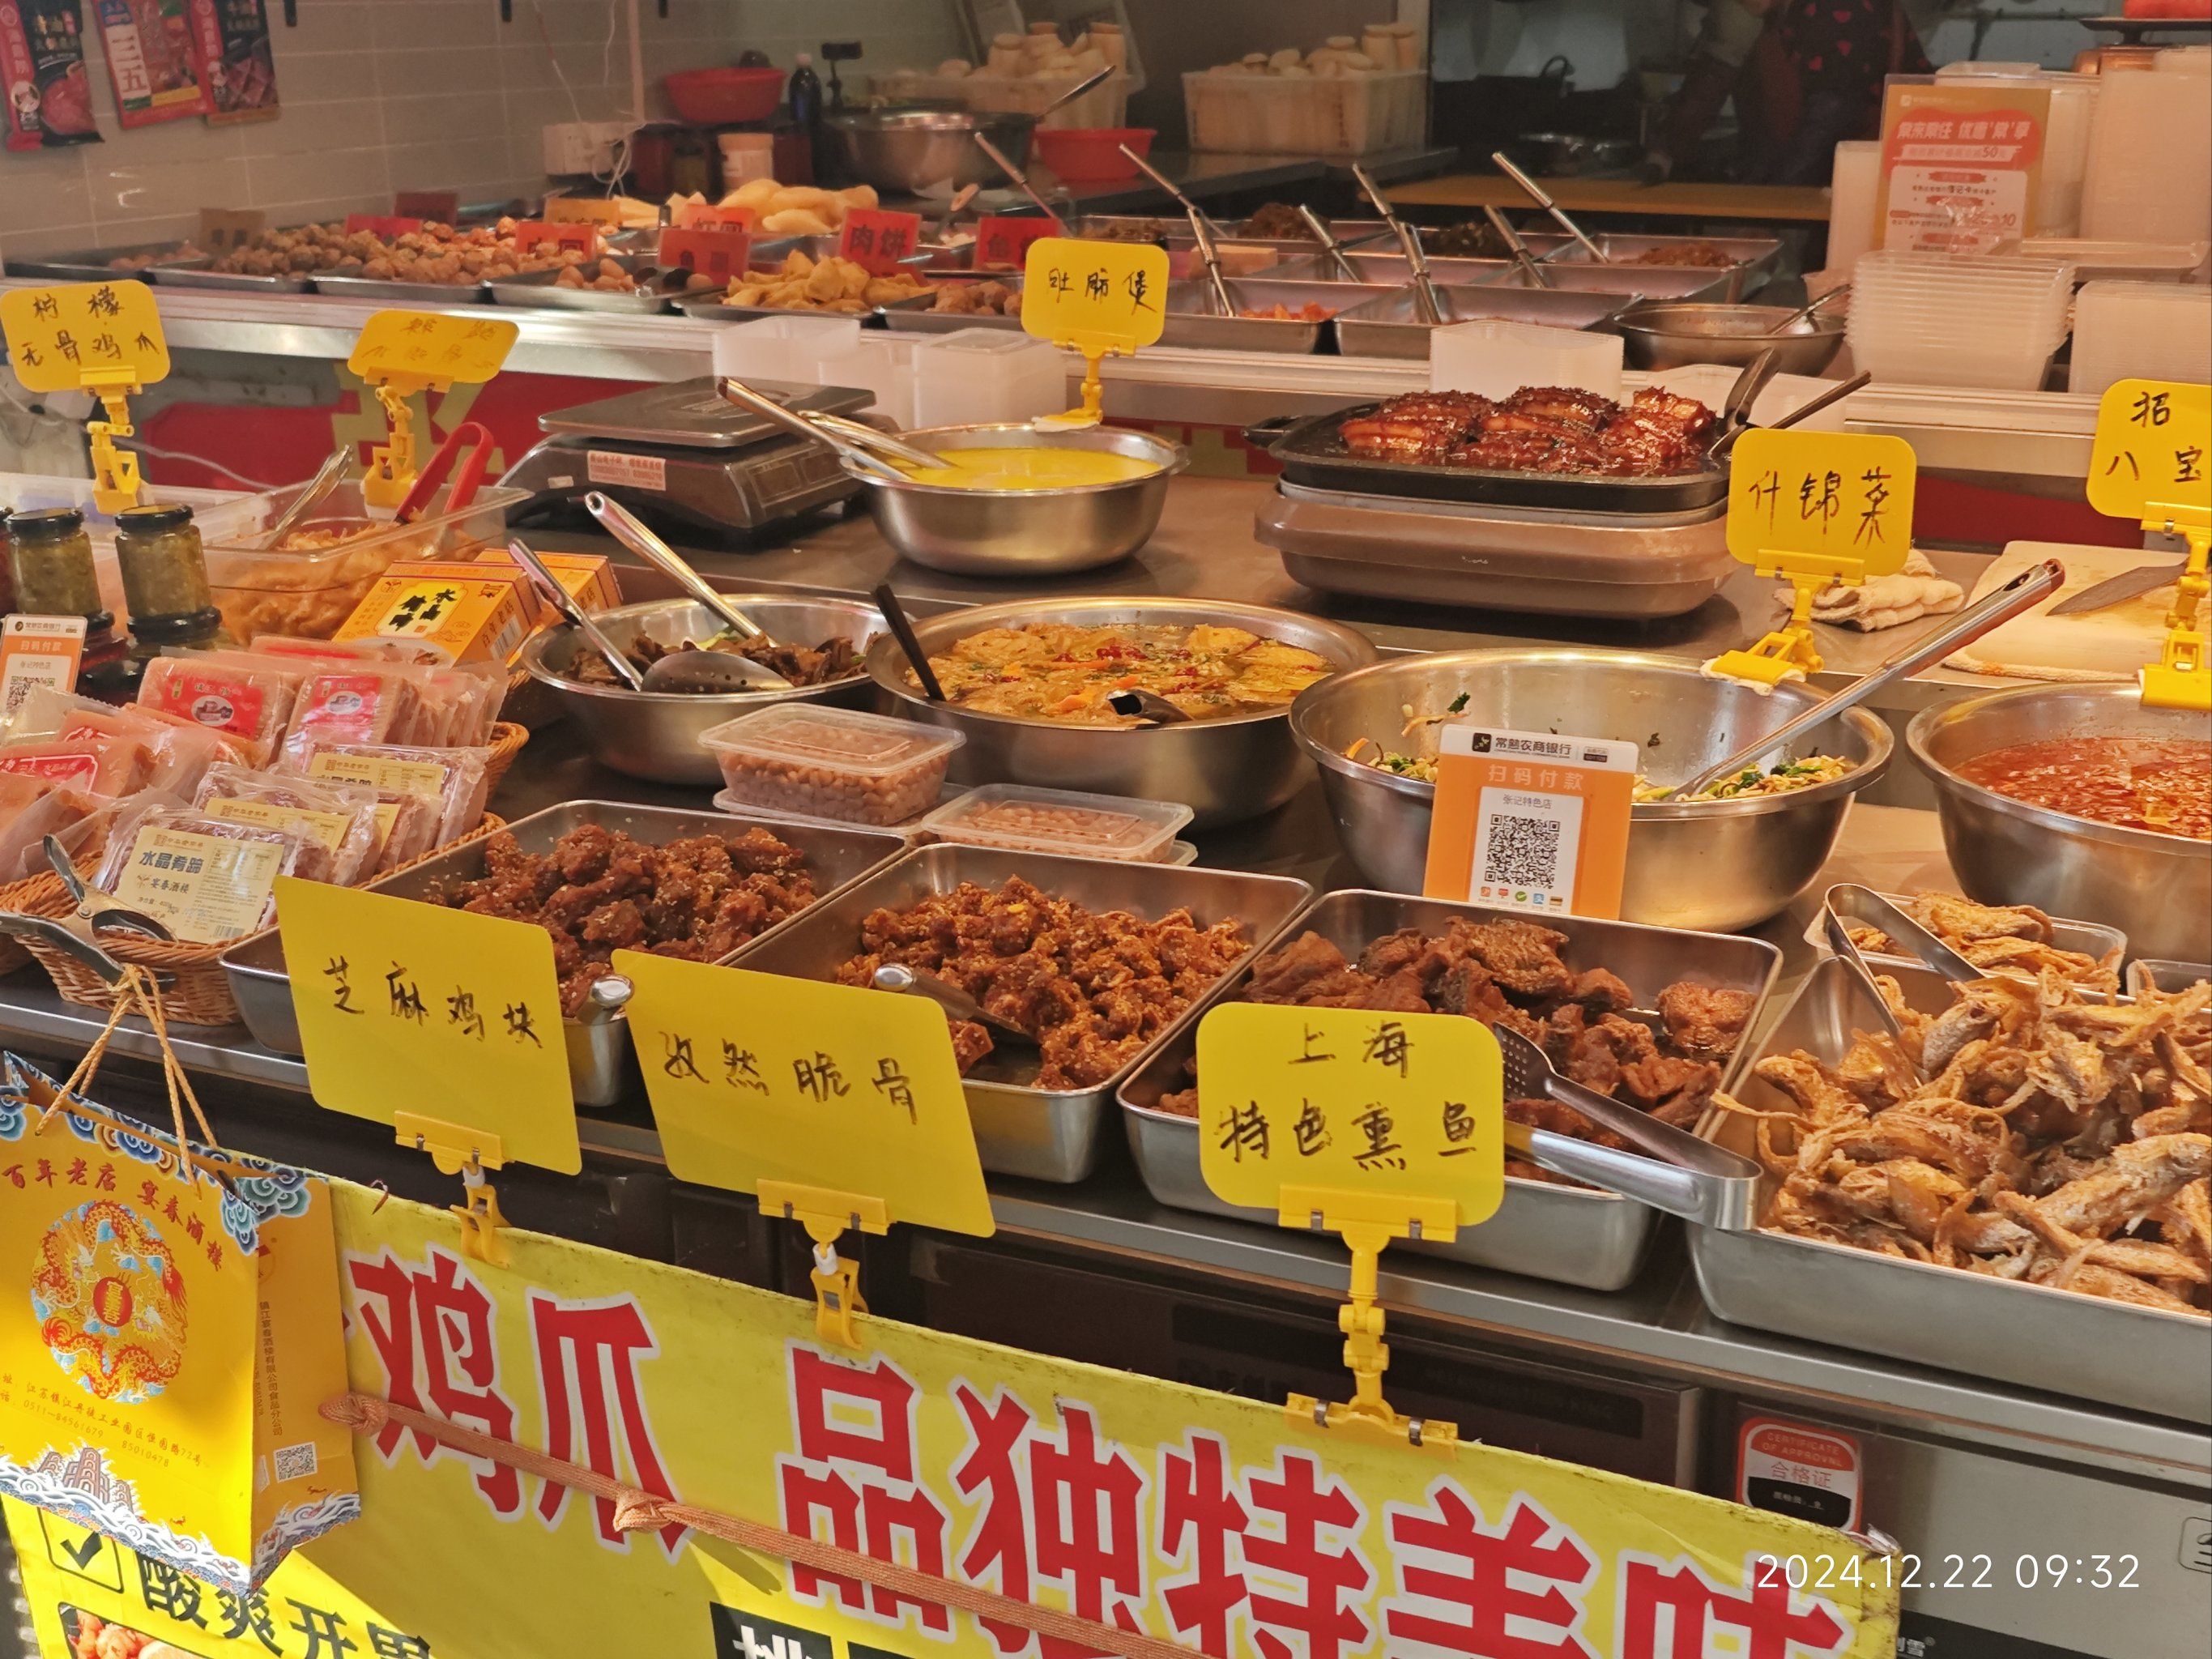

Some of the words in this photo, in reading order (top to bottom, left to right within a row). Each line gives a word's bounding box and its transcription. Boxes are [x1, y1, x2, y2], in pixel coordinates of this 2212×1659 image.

[33, 285, 124, 321] 柠檬
[22, 330, 160, 365] 无骨鸡爪
[2130, 391, 2170, 428] 招
[2106, 446, 2202, 482] 八宝
[1749, 467, 1889, 548] 什锦菜
[1495, 736, 1572, 756] 常熟农商银行
[1489, 764, 1585, 791] 扫码付款
[139, 851, 204, 874] 水晶肴蹄
[323, 955, 543, 1048] 芝麻鸡块
[1288, 1019, 1415, 1078] 上海
[658, 1030, 918, 1126] 孜然脆骨
[1213, 1096, 1477, 1172] 特色熏鱼
[3, 1156, 117, 1192] 百年老店
[348, 1251, 688, 1555] 鸡爪
[1762, 1442, 1776, 1452] OF
[1767, 1432, 1840, 1456] CERTIFICATE
[1771, 1461, 1832, 1489] 合格证
[782, 1347, 1855, 1659] 品独特美味
